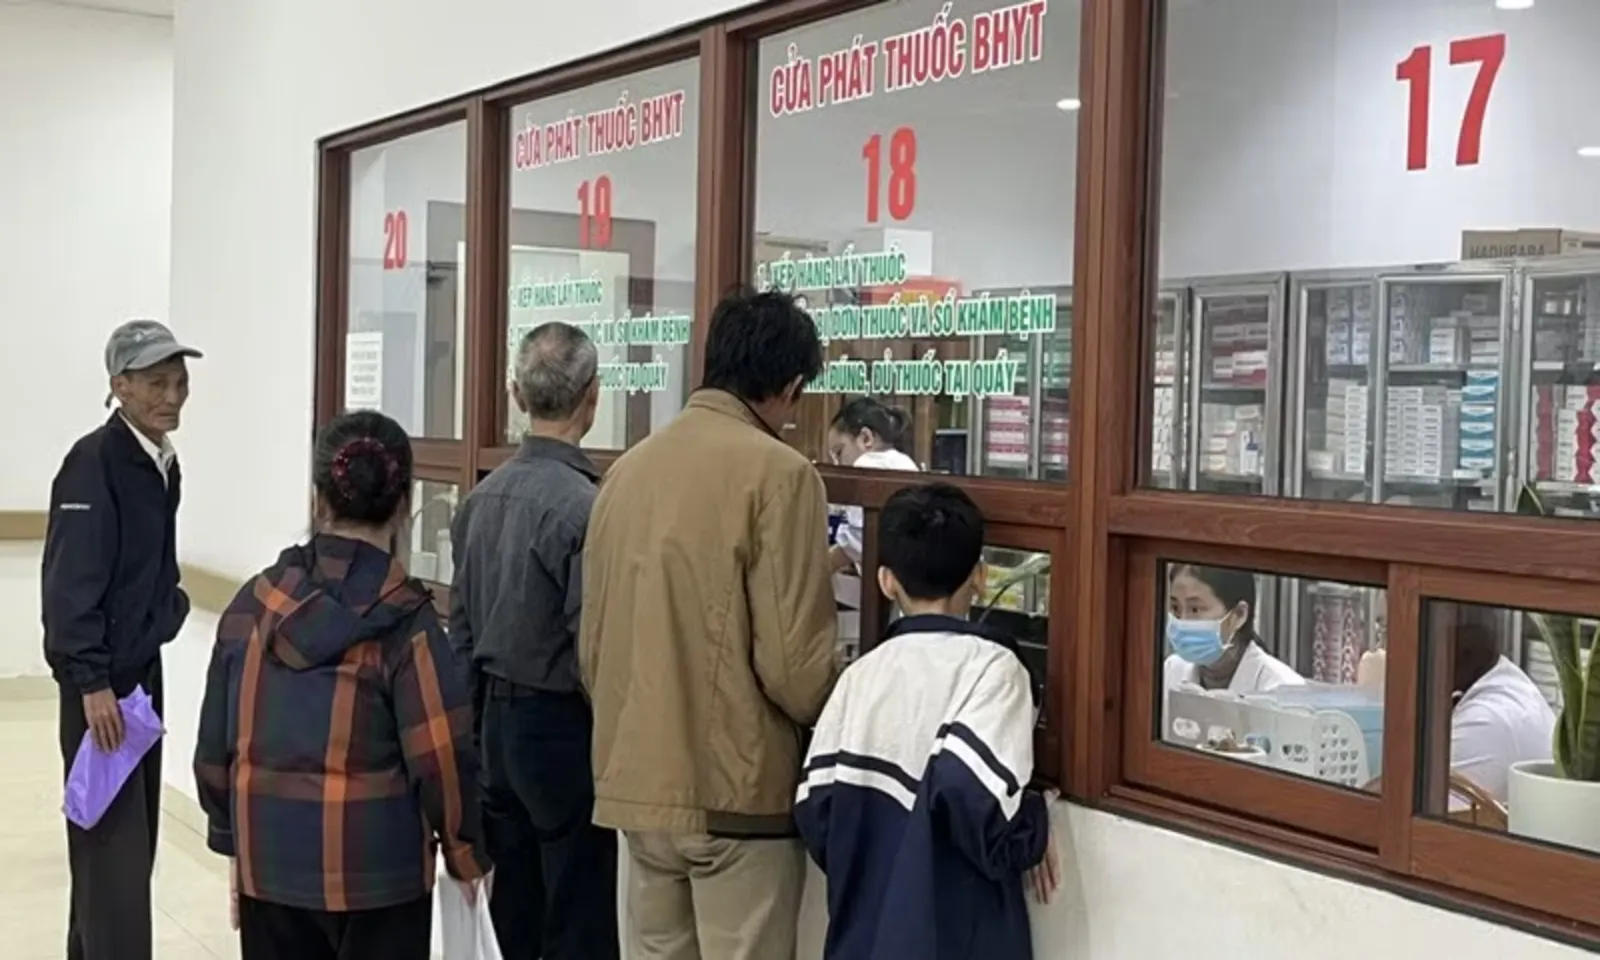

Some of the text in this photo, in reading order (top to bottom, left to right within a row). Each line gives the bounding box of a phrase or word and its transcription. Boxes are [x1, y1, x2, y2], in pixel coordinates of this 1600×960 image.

[771, 1, 1047, 117] CỬA PHÁT THUỐC BHYT
[515, 90, 685, 170] CỬA PHÁT THUỐC BHYT
[1396, 33, 1506, 171] 17
[577, 174, 613, 249] 19
[862, 126, 917, 223] 18
[383, 210, 407, 271] 20
[796, 252, 833, 290] HÀNG
[833, 243, 860, 288] LẤY
[860, 239, 908, 286] THUỐC
[861, 293, 909, 338] THUỐC
[909, 295, 931, 337] VÀ
[931, 288, 957, 337] SỔ
[956, 292, 1007, 335] KHÁM
[1007, 288, 1056, 341] BỆNH
[872, 348, 895, 394] ĐỦ
[895, 348, 943, 395] THUỐC
[944, 360, 971, 402] TẠI
[971, 348, 1018, 400] QUẦY
